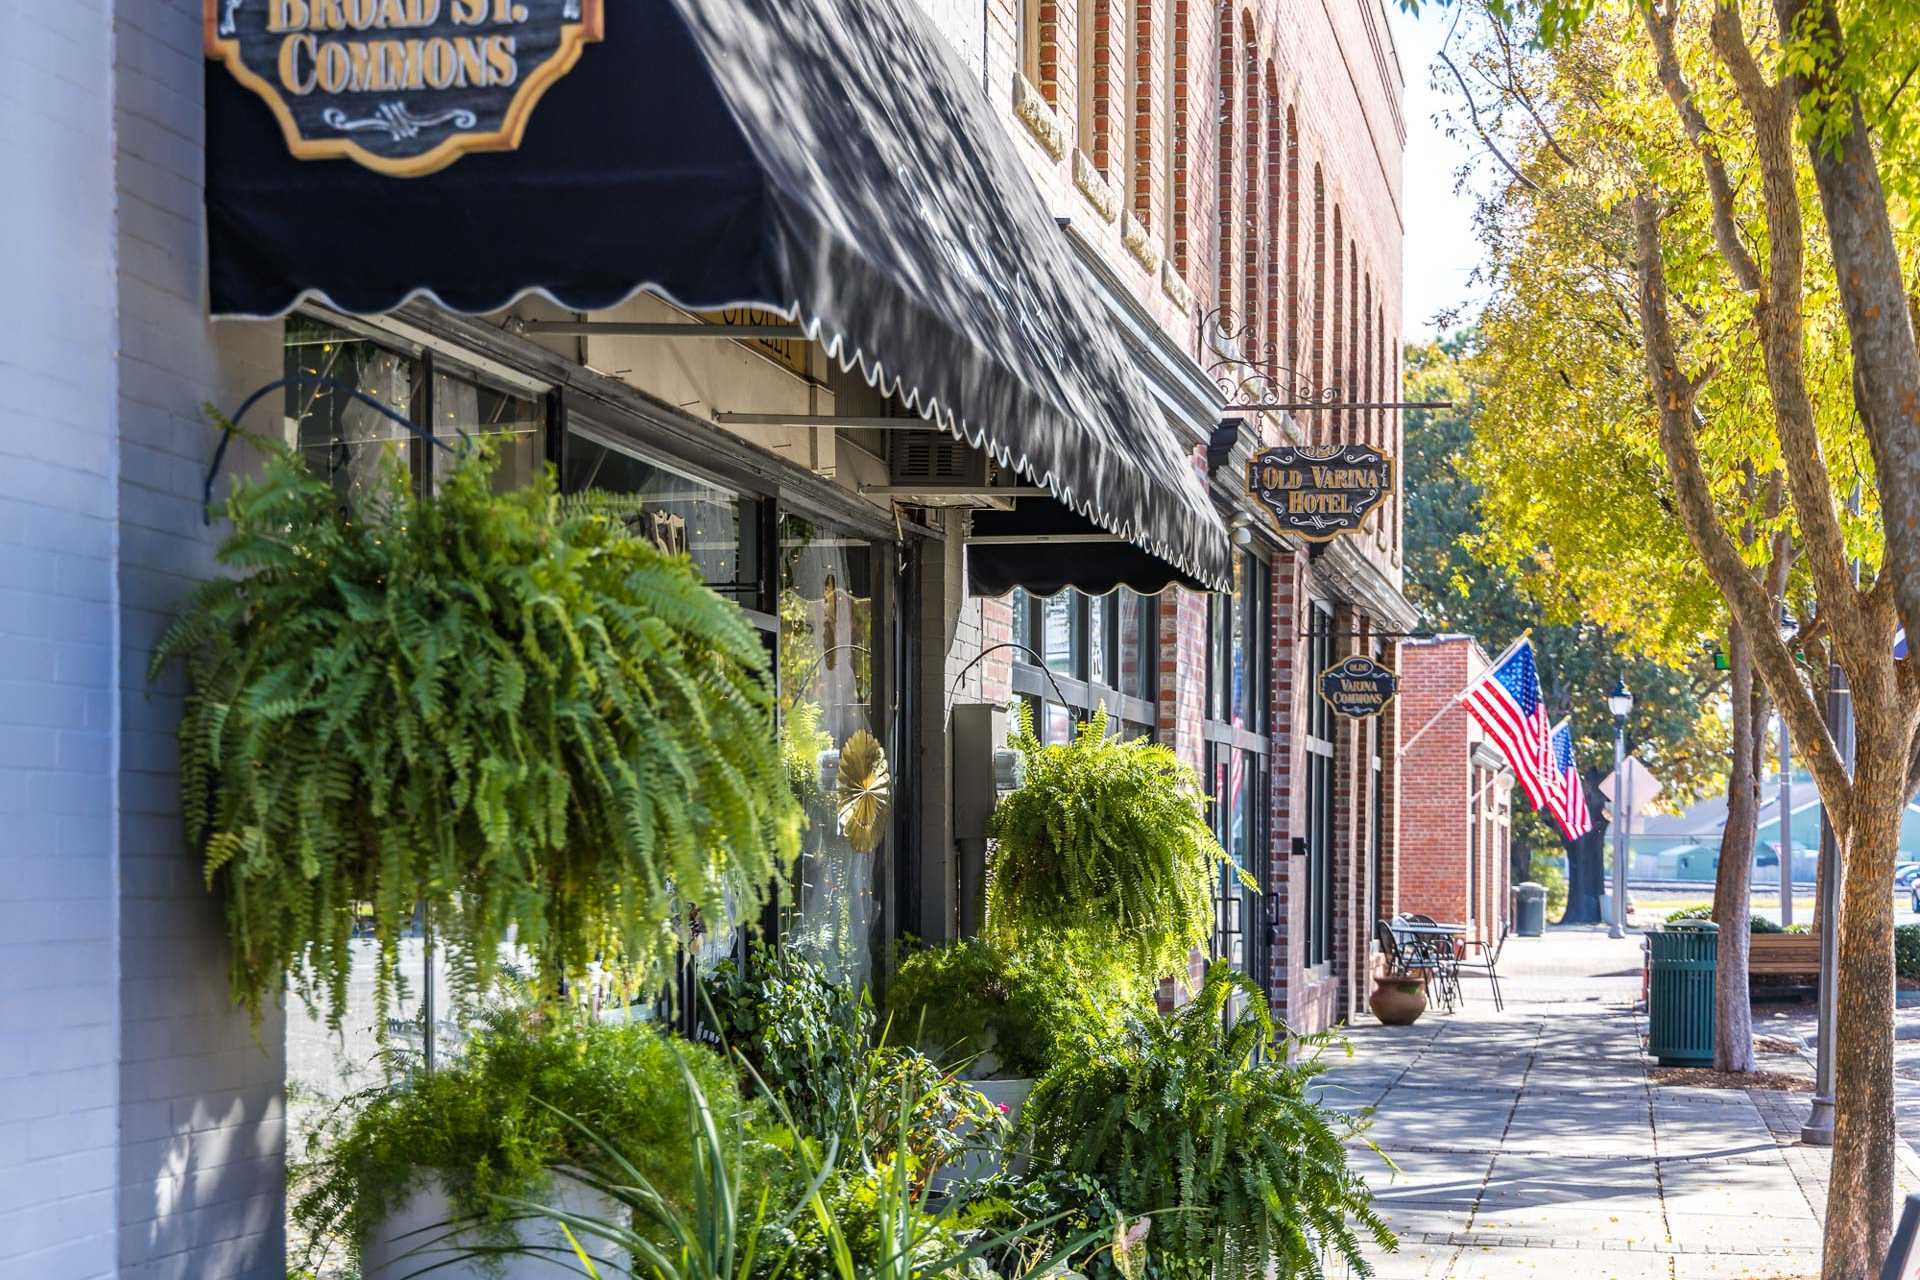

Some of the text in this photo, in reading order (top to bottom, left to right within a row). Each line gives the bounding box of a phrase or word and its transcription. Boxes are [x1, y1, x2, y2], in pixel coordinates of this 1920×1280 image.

[267, 0, 439, 32] BROAD
[278, 33, 518, 96] COMMONS
[1262, 465, 1378, 489] OLD VARINA
[1288, 490, 1352, 514] HOTEL
[1333, 691, 1383, 704] COMMONS
[1340, 679, 1378, 692] VARINA
